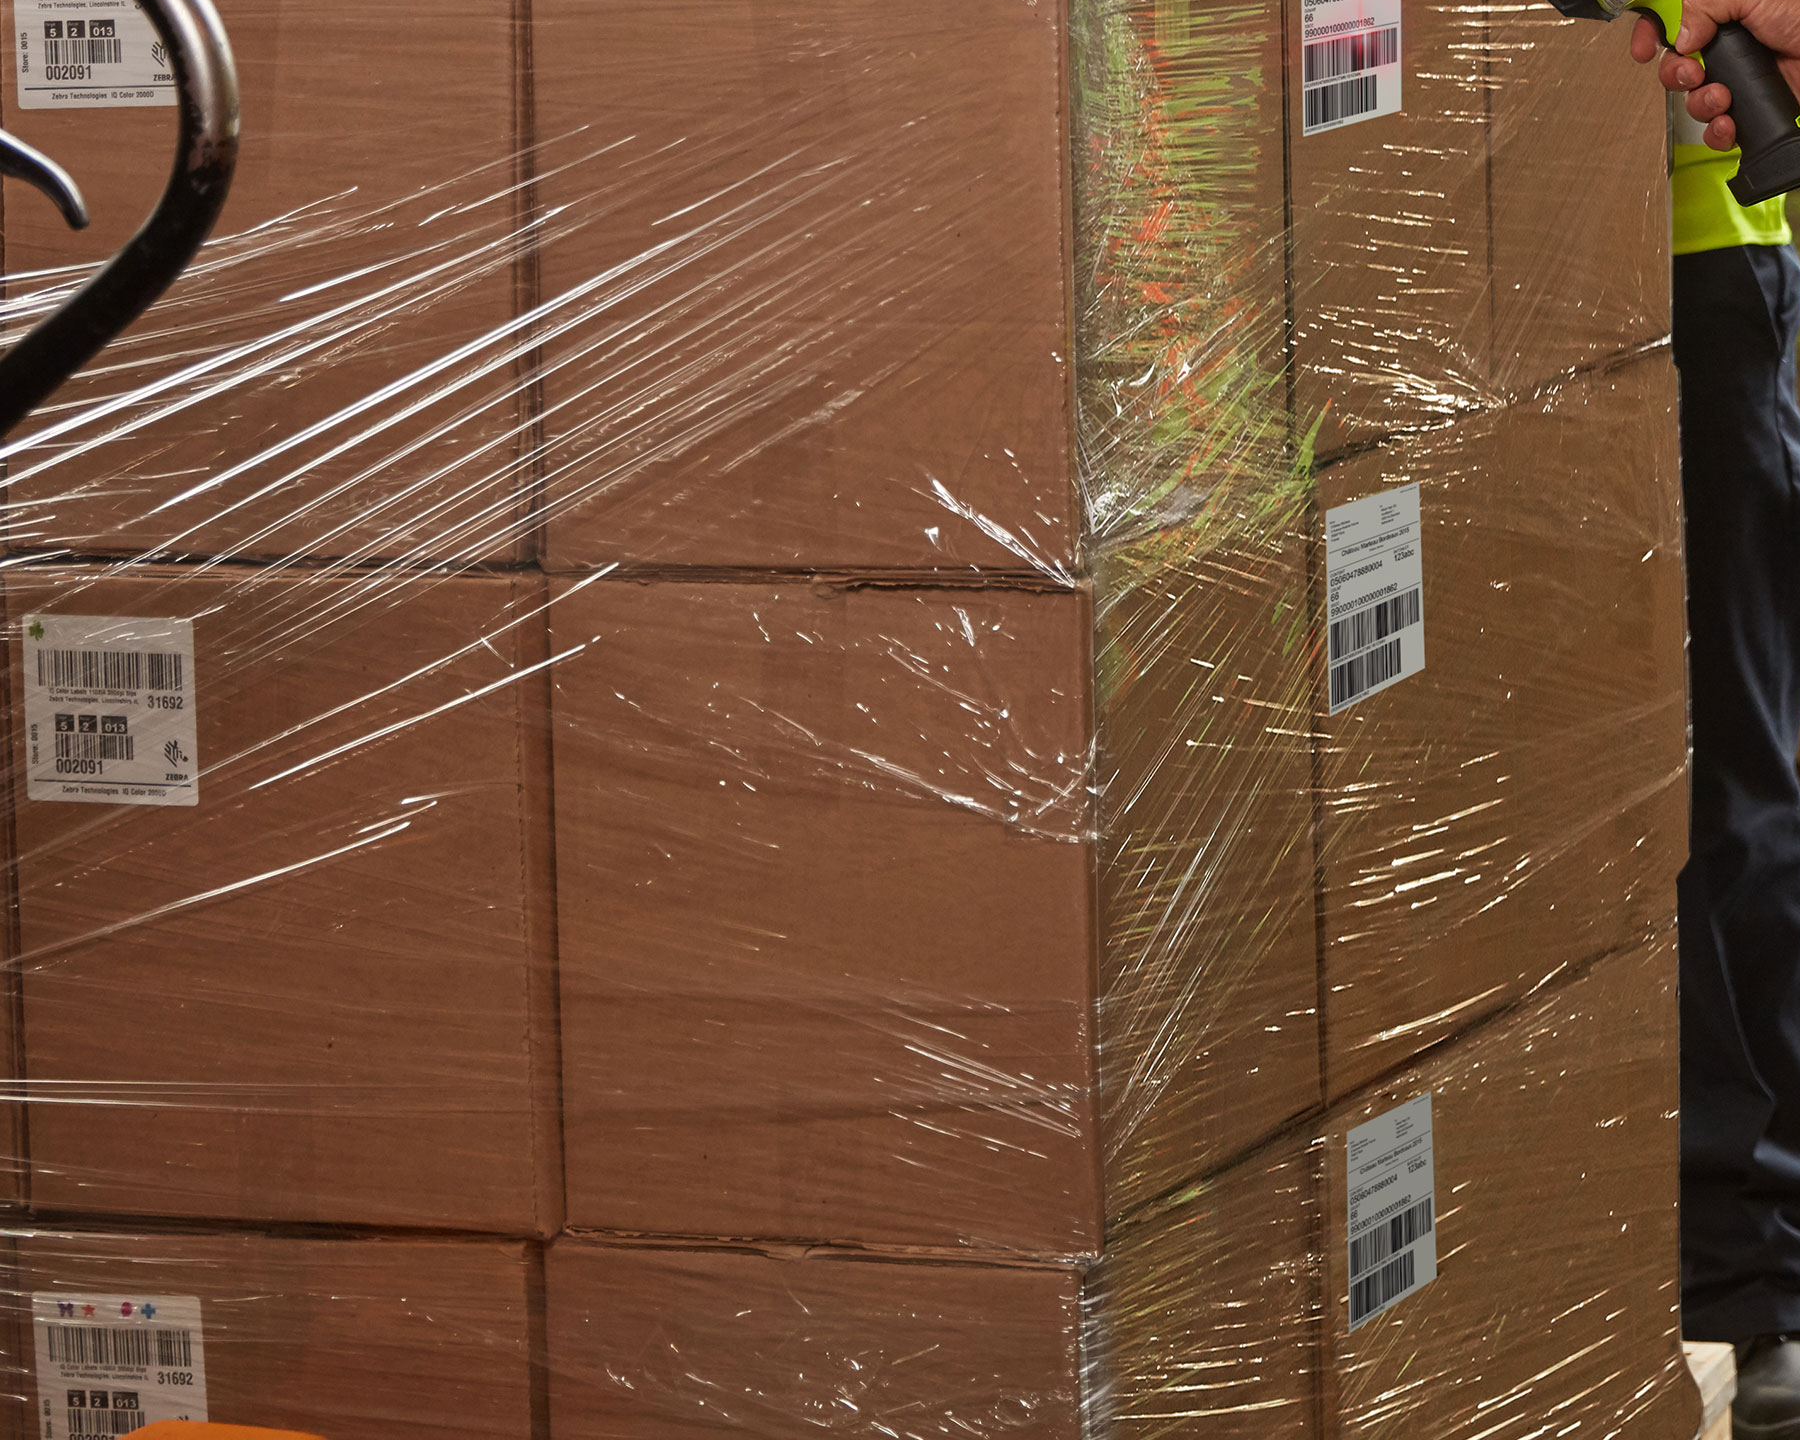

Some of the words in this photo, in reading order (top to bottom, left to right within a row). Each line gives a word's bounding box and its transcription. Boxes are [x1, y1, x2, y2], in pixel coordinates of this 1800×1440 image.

[1304, 13, 1314, 23] 66
[50, 28, 57, 37] 5
[70, 27, 78, 37] 2
[93, 26, 113, 36] 013
[21, 52, 29, 73] Store:
[45, 65, 92, 80] 002091
[70, 92, 107, 100] Technologies
[111, 92, 117, 100] IQ
[1378, 532, 1398, 543] Bordeaux
[1399, 527, 1410, 536] 2015
[1394, 549, 1415, 562] 123abc
[1330, 560, 1383, 587] 05060478880004
[1330, 592, 1339, 602] 66
[147, 695, 183, 710] 31692
[60, 722, 68, 730] 5
[82, 722, 89, 731] 2
[105, 723, 125, 732] 013
[56, 758, 103, 775] 002091
[165, 773, 189, 781] ZEBRA
[81, 786, 118, 796] Technologies
[130, 788, 146, 796] Color
[1408, 1159, 1427, 1174] 123abc
[1350, 1210, 1358, 1220] 66
[157, 1371, 193, 1385] 31692
[73, 1397, 79, 1406] 5
[94, 1398, 101, 1406] 2
[116, 1399, 137, 1408] 013
